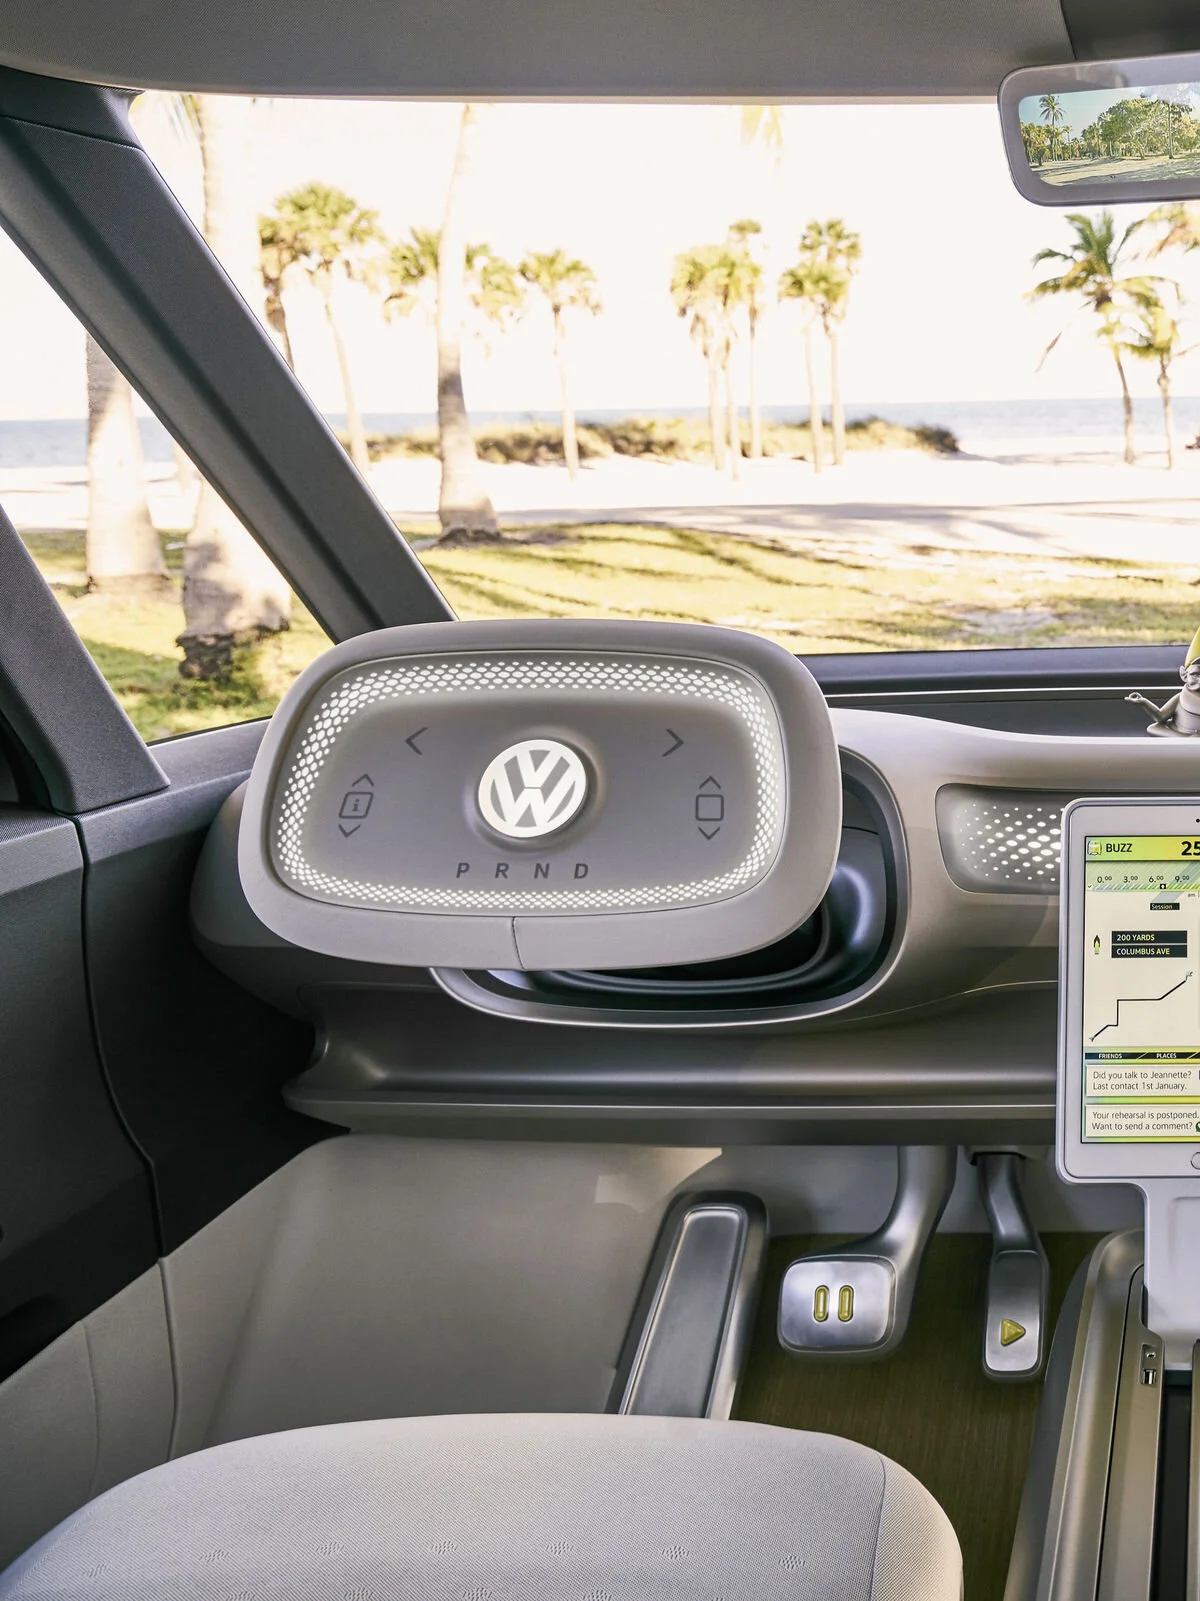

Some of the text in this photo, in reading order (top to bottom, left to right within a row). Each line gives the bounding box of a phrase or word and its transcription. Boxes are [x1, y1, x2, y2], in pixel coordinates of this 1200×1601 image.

[1106, 843, 1132, 852] BUZZ
[457, 863, 590, 879] P R N D
[1108, 1073, 1122, 1081] you
[1155, 1082, 1187, 1091] January.
[1156, 1111, 1199, 1120] postponed.
[1125, 1122, 1144, 1130] send
